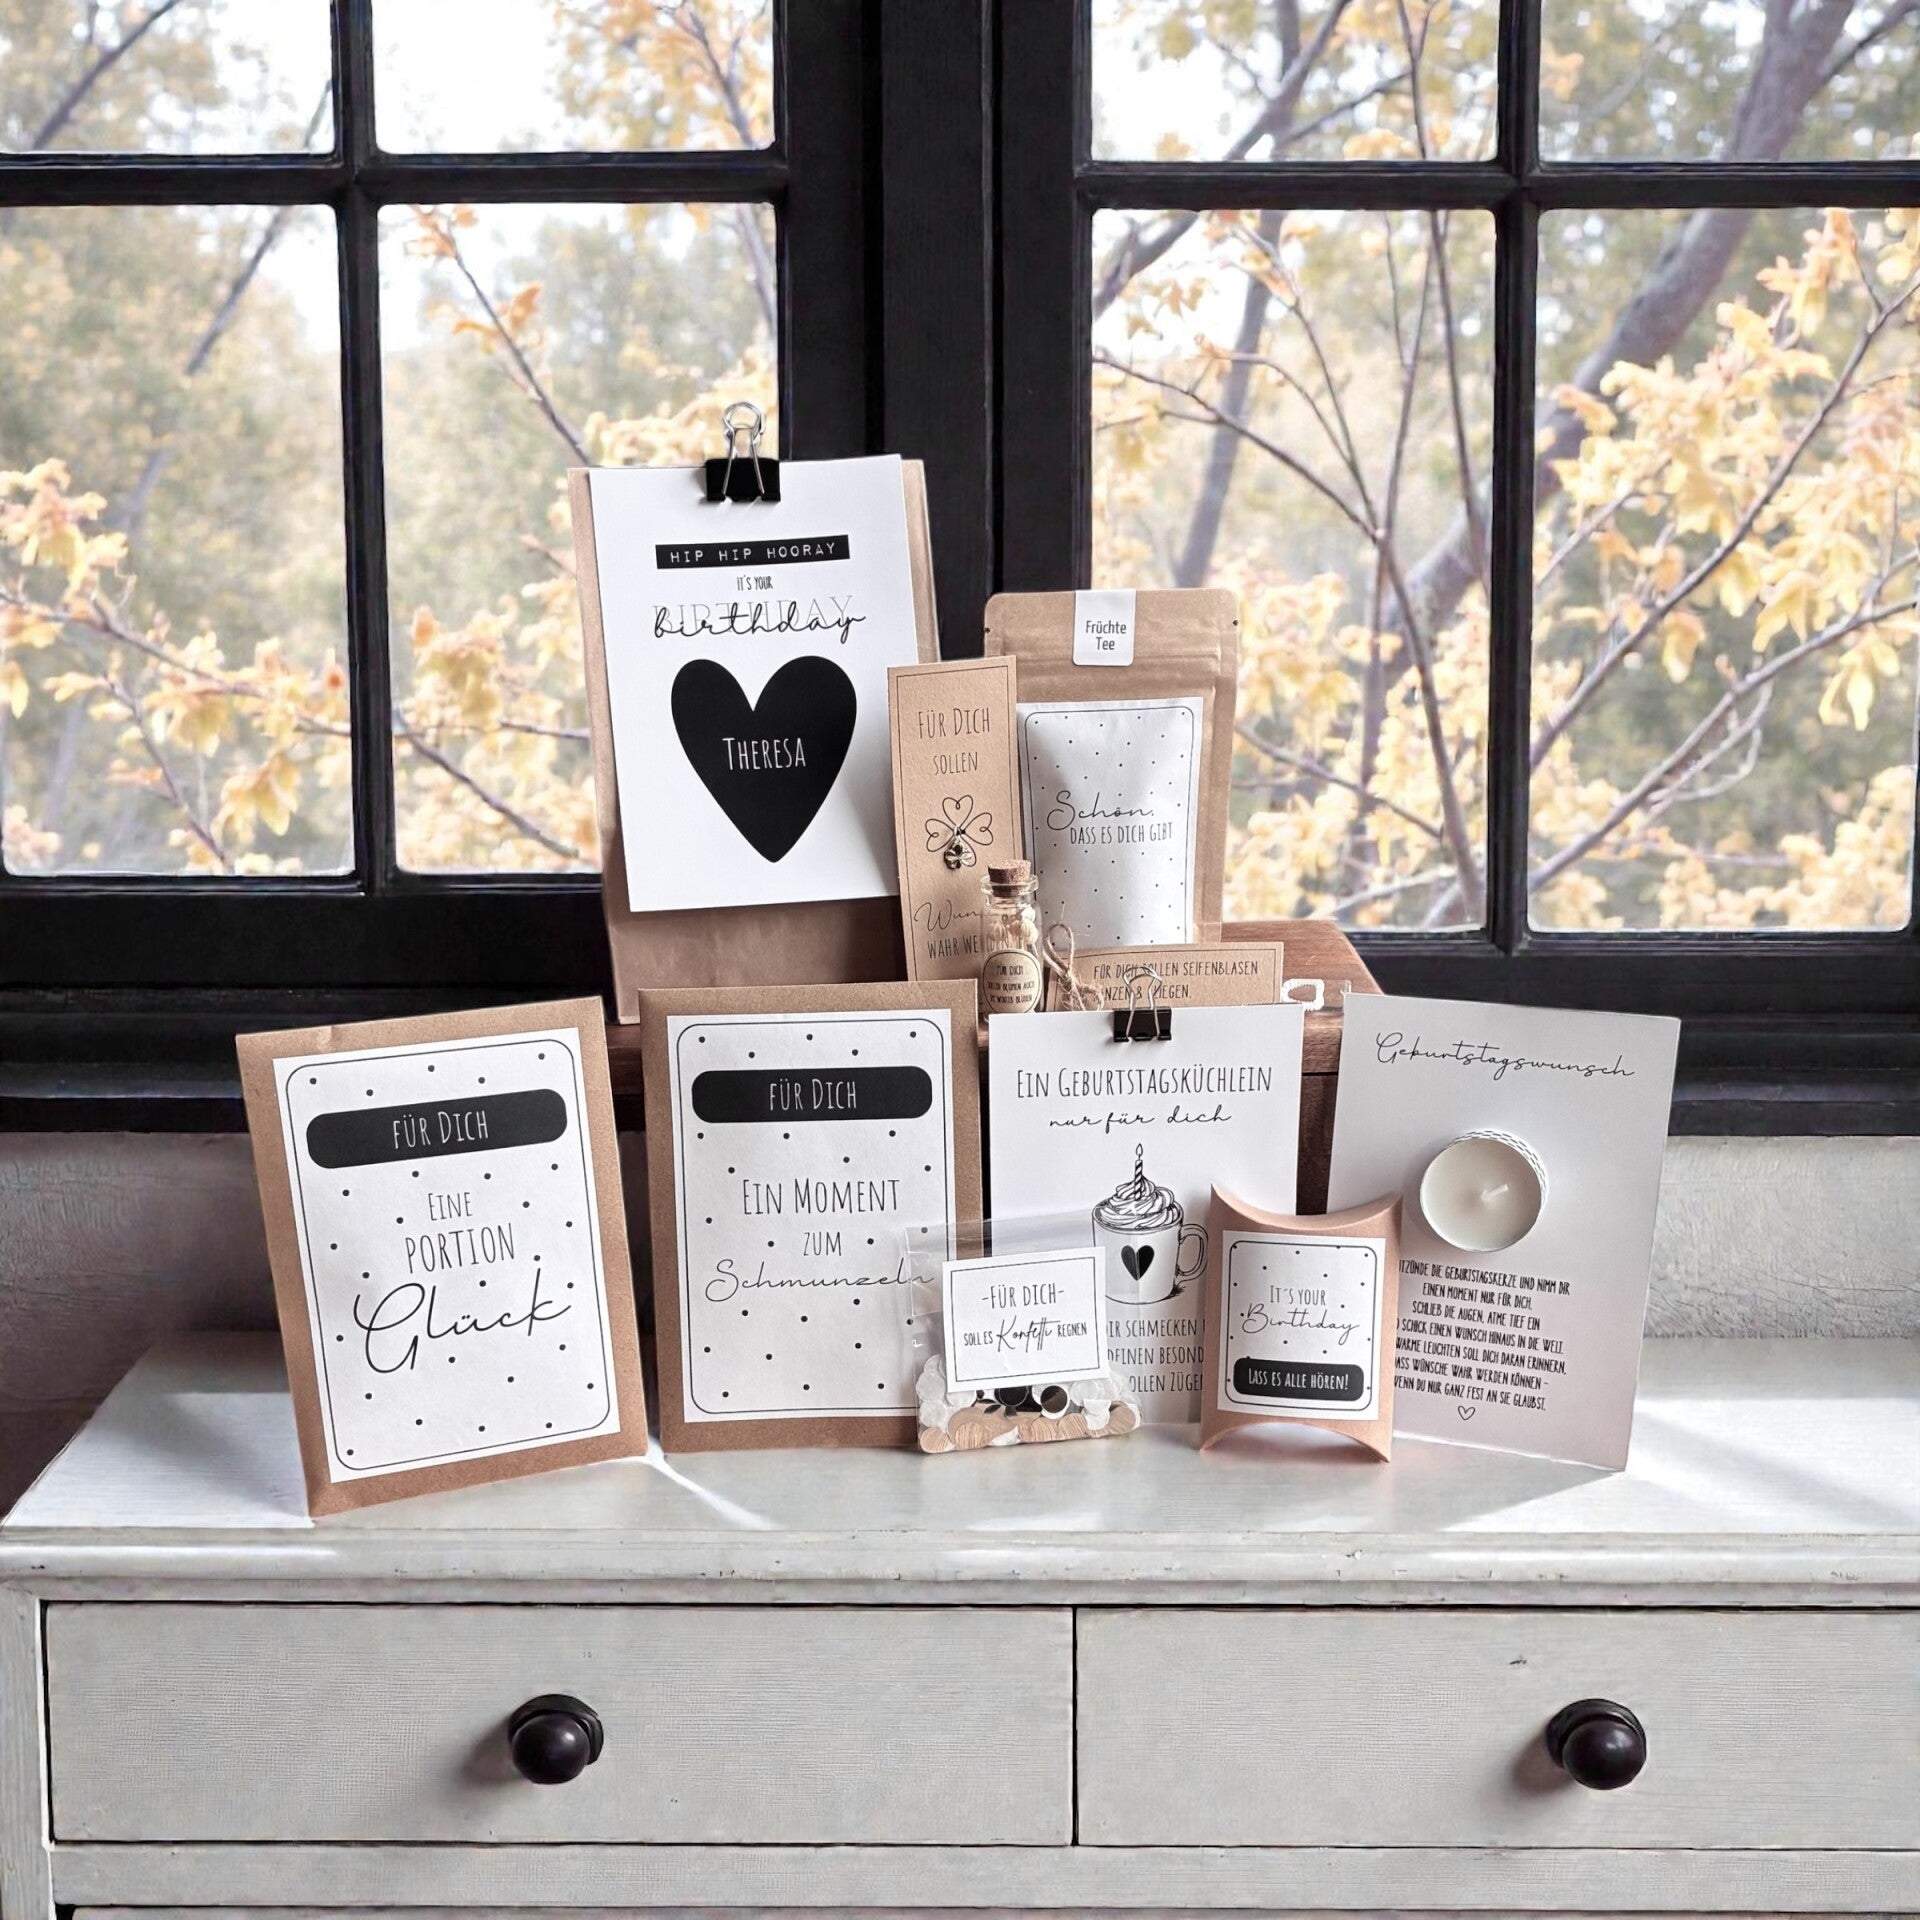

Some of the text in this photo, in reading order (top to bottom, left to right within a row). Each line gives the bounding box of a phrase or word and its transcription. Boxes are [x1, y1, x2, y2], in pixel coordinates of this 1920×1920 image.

[670, 542, 835, 563] HIP HIP HOORAY
[754, 576, 773, 590] YOUR
[654, 601, 866, 644] birthday
[1085, 620, 1127, 634] Früchte
[1096, 636, 1115, 650] Tee
[918, 707, 990, 739] FÜR DICH
[723, 737, 806, 771] THERESA
[933, 752, 978, 775] SOLLEN
[1070, 822, 1173, 844] DASS ES DICH GIBT
[927, 938, 960, 958] WAHR
[1094, 964, 1111, 979] FÜR
[1183, 961, 1258, 976] SEIFENBLASEN
[1136, 985, 1143, 999] &
[1376, 1032, 1635, 1081] Geburtstagswunsch
[769, 1078, 857, 1111] FÜR DICH
[1017, 1064, 1272, 1098] EIN GEBURTSTAGSKÜCHLEIN
[393, 1110, 489, 1150] FÜR DICH
[1050, 1104, 1232, 1134] nur für dich
[427, 1191, 474, 1222] EINE
[742, 1178, 900, 1216] EIN MOMENT
[405, 1222, 516, 1274] PORTION
[803, 1230, 842, 1257] ZUM
[1431, 1264, 1443, 1278] DIE
[1445, 1266, 1517, 1288] GEBURTSTAGSKERZE
[1520, 1276, 1535, 1290] UND
[1537, 1278, 1556, 1293] NIMM
[1558, 1281, 1570, 1295] DIR
[1298, 1289, 1326, 1306] YOUR
[1422, 1282, 1445, 1297] EINEN
[1447, 1285, 1478, 1302] MOMENT
[1480, 1290, 1495, 1305] NUR
[1497, 1292, 1511, 1307] FÜR
[353, 1268, 572, 1374] Glück
[1126, 1318, 1197, 1337] SCHMECKEN
[1242, 1303, 1360, 1345] Birthday
[1444, 1304, 1456, 1319] DIE
[1487, 1311, 1507, 1326] ATME
[1510, 1313, 1526, 1328] TIEF
[1527, 1316, 1540, 1330] EIN
[963, 1315, 1087, 1353] SOLL ES Konfetti REGNEN
[1402, 1319, 1427, 1334] SCHICK
[1429, 1322, 1452, 1337] EINEN
[1455, 1326, 1487, 1343] WUNSCH
[1488, 1331, 1516, 1347] HINAUS
[1518, 1334, 1526, 1348] IN
[1527, 1336, 1540, 1351] DIE
[1423, 1341, 1460, 1358] LEUCHTEN
[1463, 1346, 1479, 1361] SOLL
[1482, 1349, 1499, 1364] DICH
[1501, 1352, 1525, 1368] DARAN
[1248, 1368, 1349, 1390] LASS ES ALLE HÖREN!
[1412, 1358, 1448, 1376] WÜNSCHE
[1451, 1364, 1472, 1379] WAHR
[1476, 1368, 1508, 1385] WERDEN
[1510, 1372, 1541, 1389] KÖNNEN
[1416, 1378, 1426, 1392] DU
[1428, 1380, 1442, 1394] NUR
[1444, 1383, 1465, 1398] GANZ
[1467, 1386, 1484, 1401] FEST
[1486, 1389, 1498, 1402] AN
[1500, 1391, 1512, 1405] SIE
